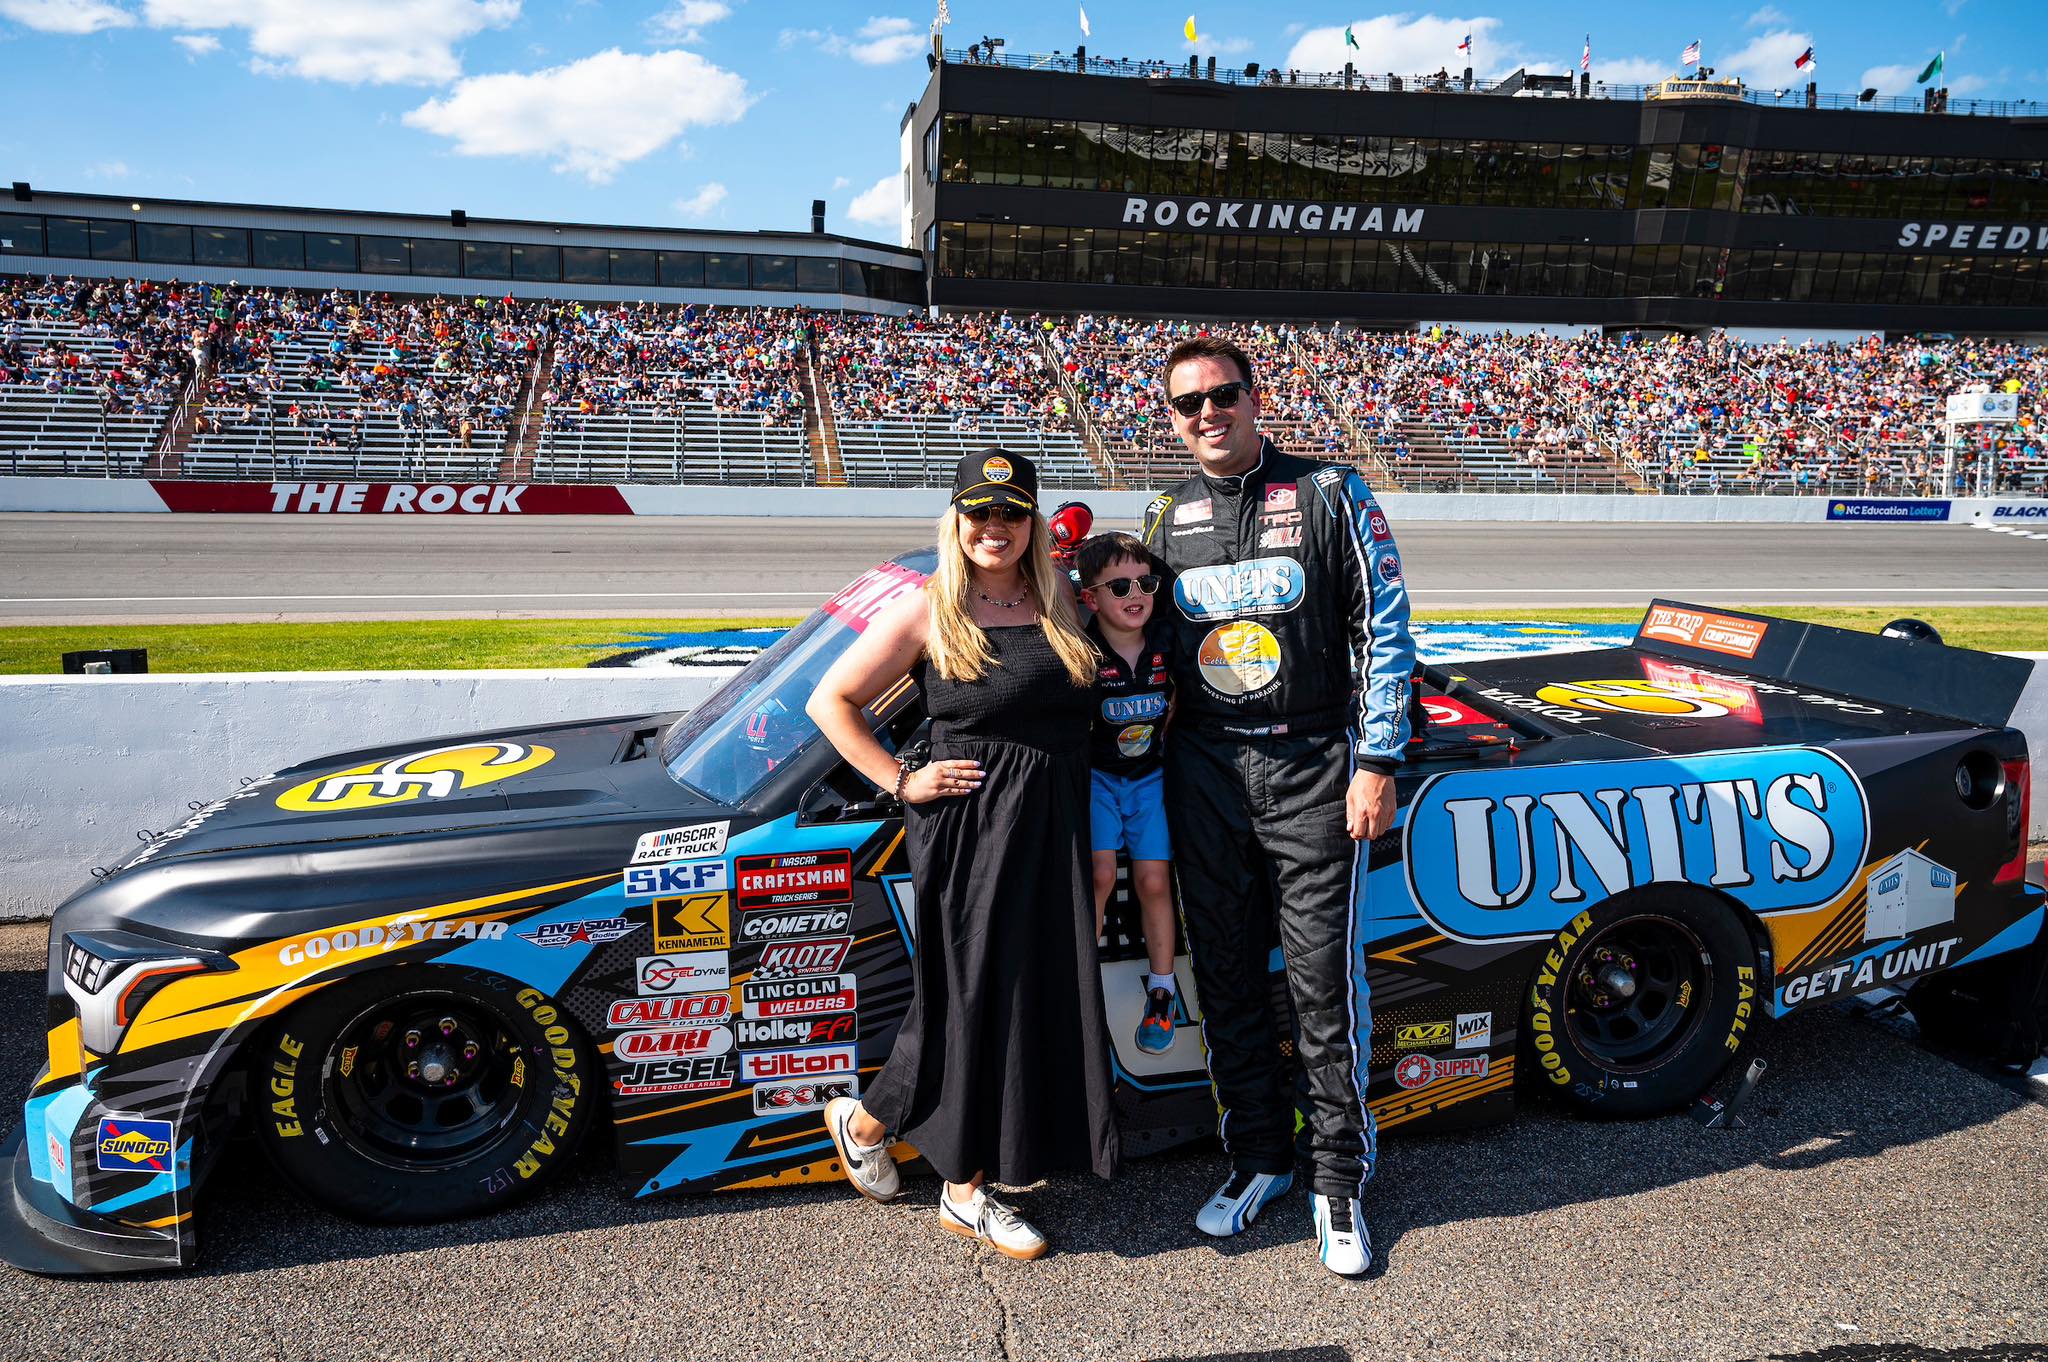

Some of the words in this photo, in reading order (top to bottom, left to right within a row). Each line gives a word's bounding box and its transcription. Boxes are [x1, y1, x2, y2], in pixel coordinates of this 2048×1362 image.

[1122, 198, 1425, 233] ROCKINGHAM
[269, 483, 370, 513] THE
[382, 484, 530, 514] ROCK
[1259, 511, 1302, 526] TRD
[1845, 505, 1860, 515] NC
[1861, 505, 1909, 516] Education
[1909, 505, 1944, 517] Lottery
[1182, 565, 1291, 606] UNITS
[1649, 609, 1674, 626] THE
[1674, 612, 1704, 633] TRIP
[1201, 684, 1236, 704] INVESTING
[1249, 680, 1282, 700] PARADISE
[1108, 695, 1162, 716] UNITS
[1477, 688, 1602, 725] TOYOTA
[665, 826, 717, 845] NASCAR
[1443, 771, 1836, 910] UNITS
[638, 847, 672, 860] RACE
[676, 842, 718, 855] TRUCK
[782, 856, 817, 867] NASCAR
[627, 863, 724, 895] SKF
[742, 870, 846, 891] CRAFTSMAN
[771, 894, 795, 903] TRUCK
[794, 892, 818, 902] SERIES
[538, 922, 578, 937] FIVE
[584, 917, 626, 932] STAR
[744, 910, 848, 936] COMETIC
[279, 918, 509, 966] GOODYEAR
[537, 936, 570, 944] RaceCar
[658, 936, 726, 950] KENNAMETAL
[766, 943, 842, 969] KLOTZ
[797, 966, 833, 974] SYNTHETICS
[1784, 964, 1850, 1005] GET
[1852, 960, 1874, 988] A
[1882, 938, 1958, 979] UNIT
[749, 980, 836, 1000] LINCOLN
[1531, 910, 1594, 1086] GOODYEAR
[610, 994, 728, 1024] CALICO
[770, 996, 846, 1014] WELDERS
[1723, 964, 1756, 1054] EAGLE
[672, 1017, 729, 1027] COATINGS
[738, 1020, 812, 1043] Holley
[1458, 1015, 1490, 1036] WIX
[1430, 1036, 1450, 1044] WEAR
[343, 1050, 352, 1072] AERO
[622, 1057, 735, 1086] JESEL
[749, 1053, 850, 1077] tilton
[1434, 1058, 1486, 1077] SUPPLY
[271, 1033, 304, 1138] EAGLE
[513, 988, 581, 1180] GOODYEAR
[631, 1085, 659, 1093] SHAFT
[662, 1083, 695, 1091] ROCKER
[756, 1081, 854, 1108] KOOKS
[102, 1140, 168, 1155] SUNOCO
